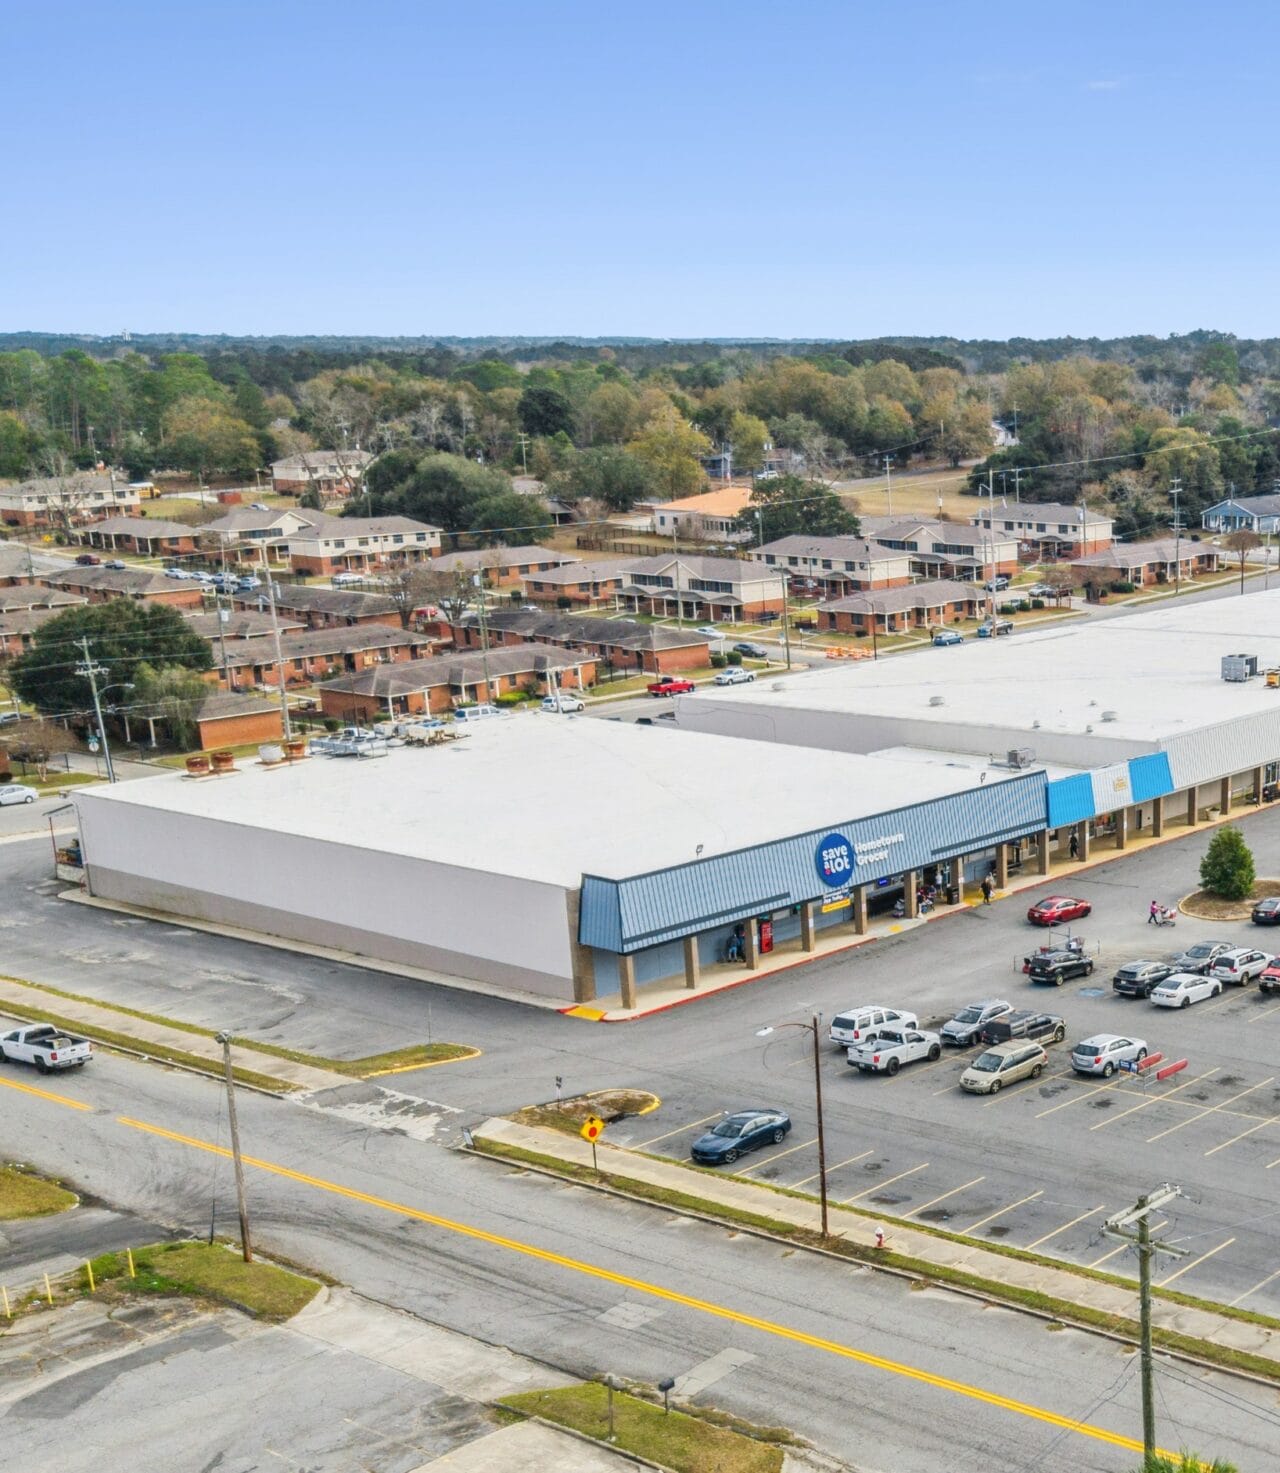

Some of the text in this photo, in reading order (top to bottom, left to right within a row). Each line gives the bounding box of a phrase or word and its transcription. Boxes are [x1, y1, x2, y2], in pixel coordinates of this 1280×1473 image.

[854, 833, 904, 854] Hometown
[822, 845, 848, 861] save
[856, 849, 889, 866] Grocer
